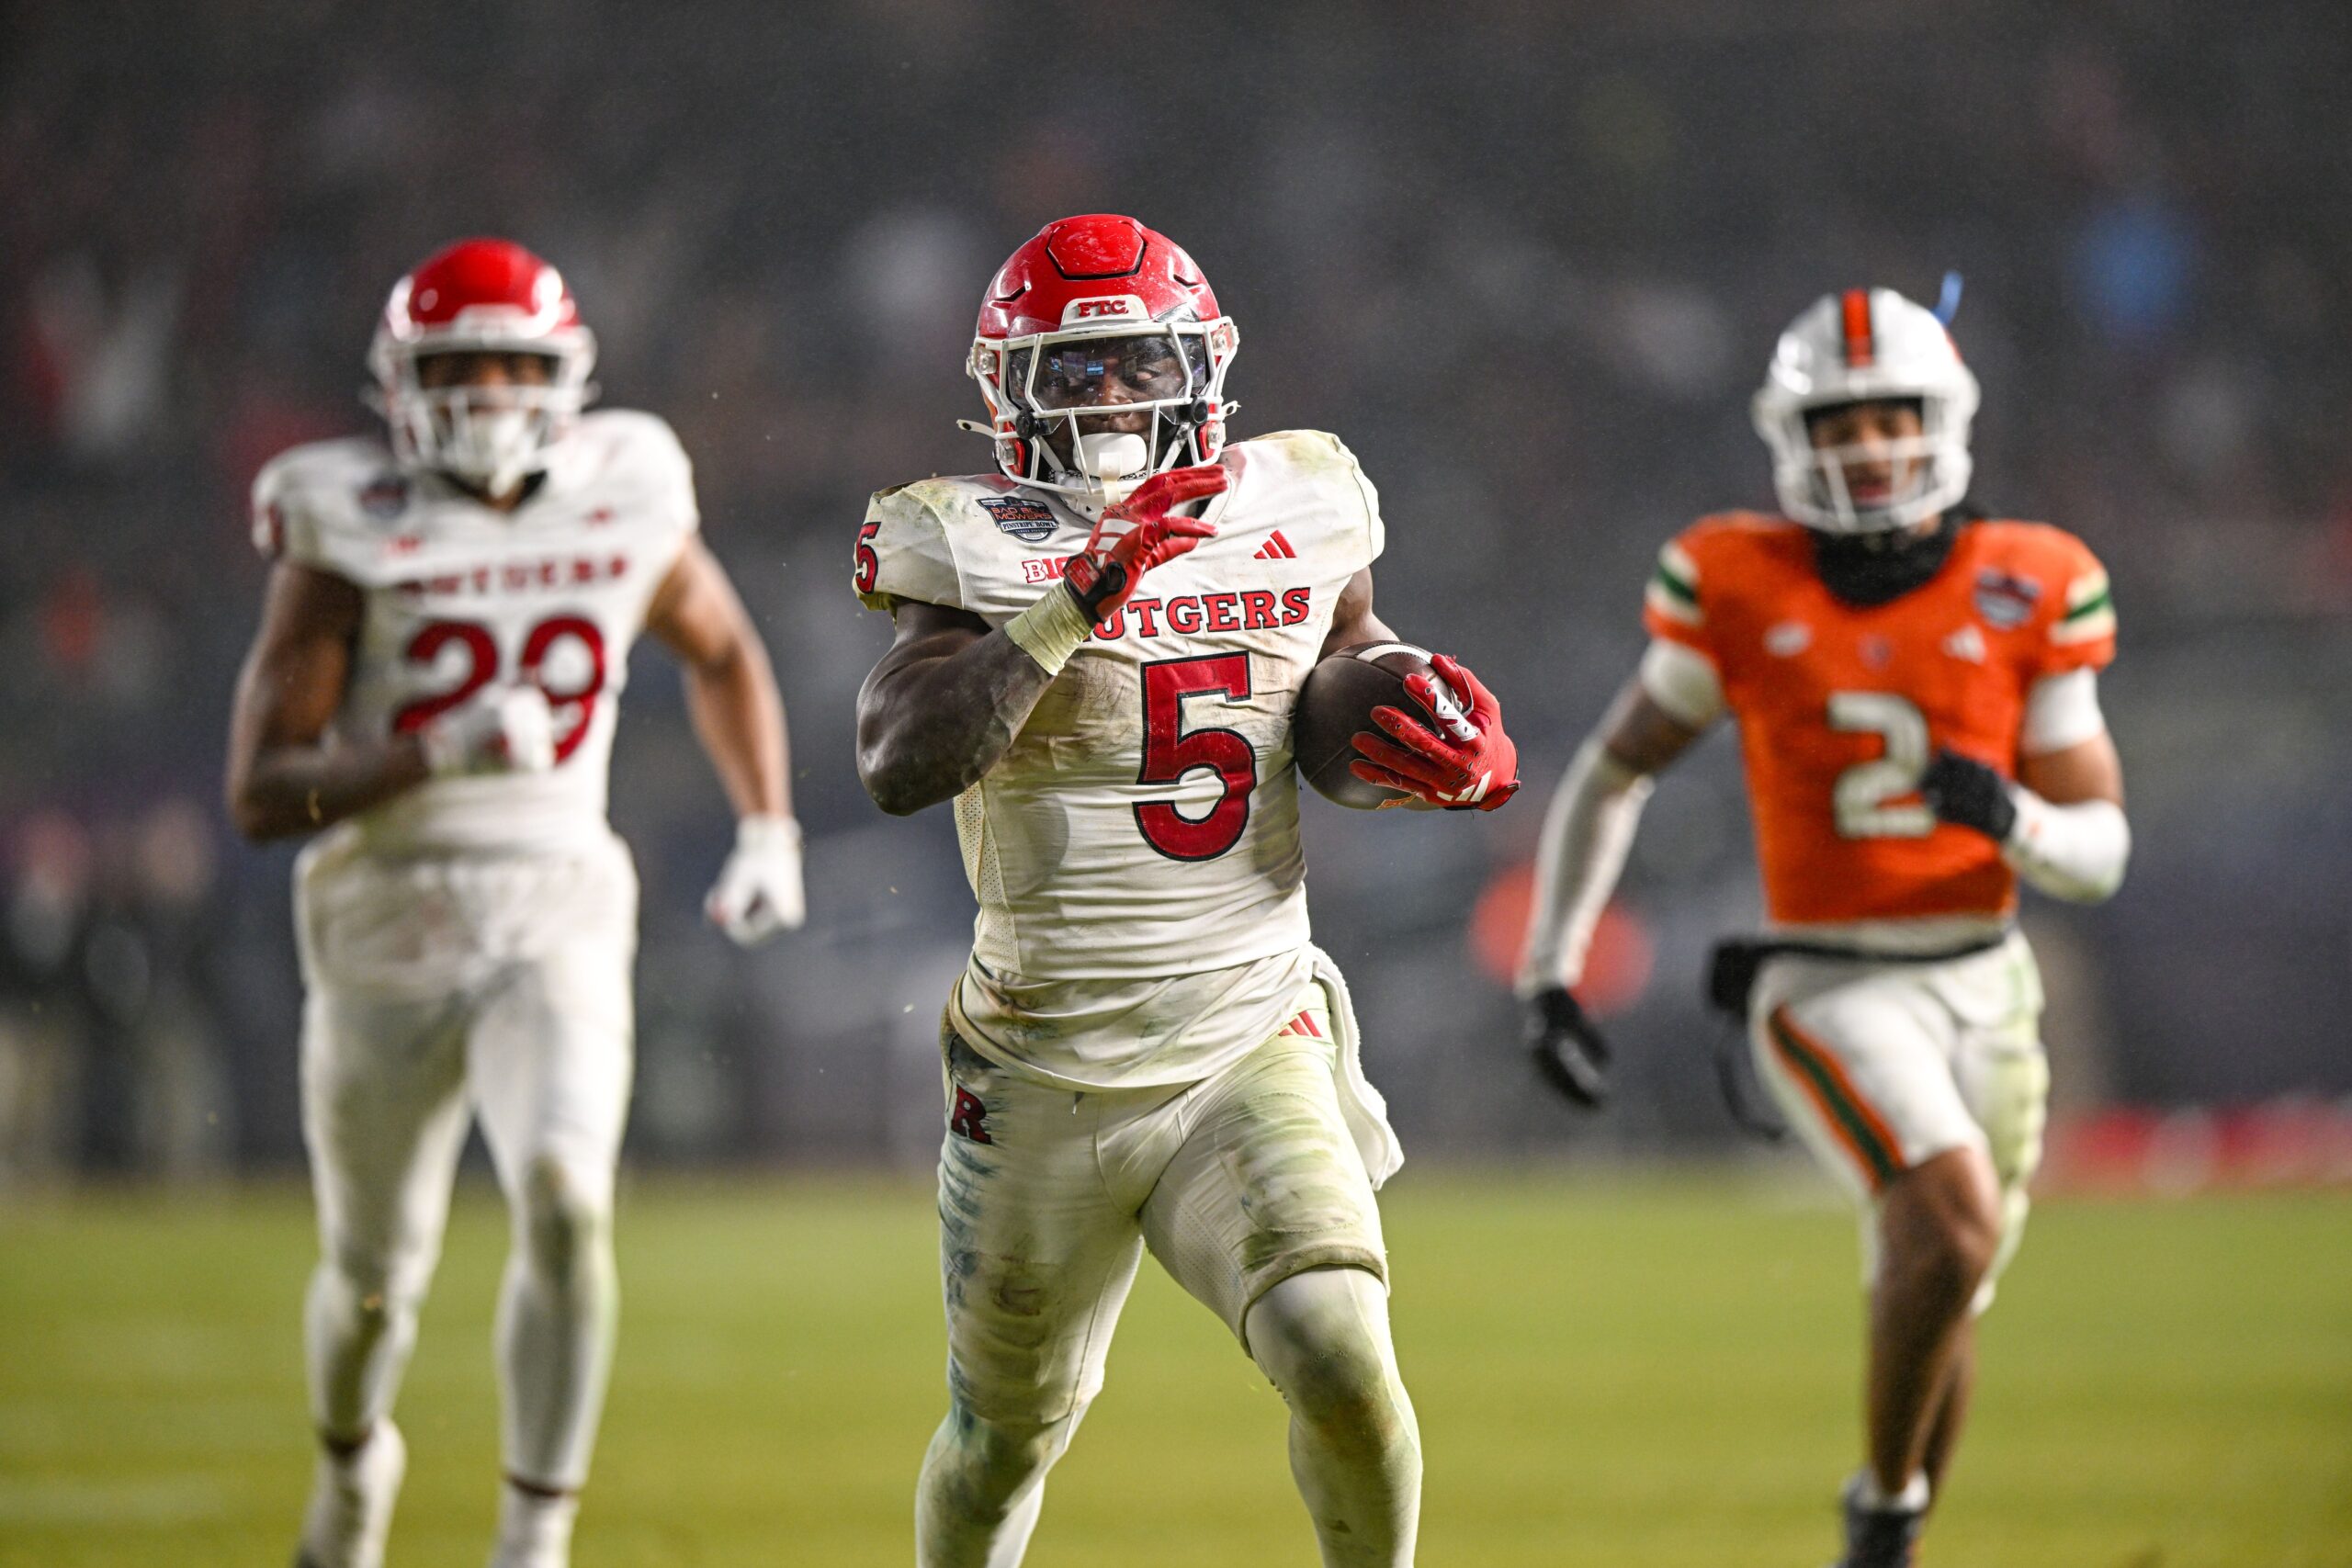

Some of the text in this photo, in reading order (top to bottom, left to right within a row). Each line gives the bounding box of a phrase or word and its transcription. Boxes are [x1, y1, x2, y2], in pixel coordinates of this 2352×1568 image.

[1078, 299, 1128, 317] FTC
[855, 521, 882, 594] 5
[1002, 522, 1035, 530] PINSTRIPE
[1083, 586, 1311, 642] UTGERS
[386, 613, 606, 770] 29
[1131, 649, 1258, 863] 5
[1825, 690, 1938, 840] 2
[950, 1083, 992, 1145] R
